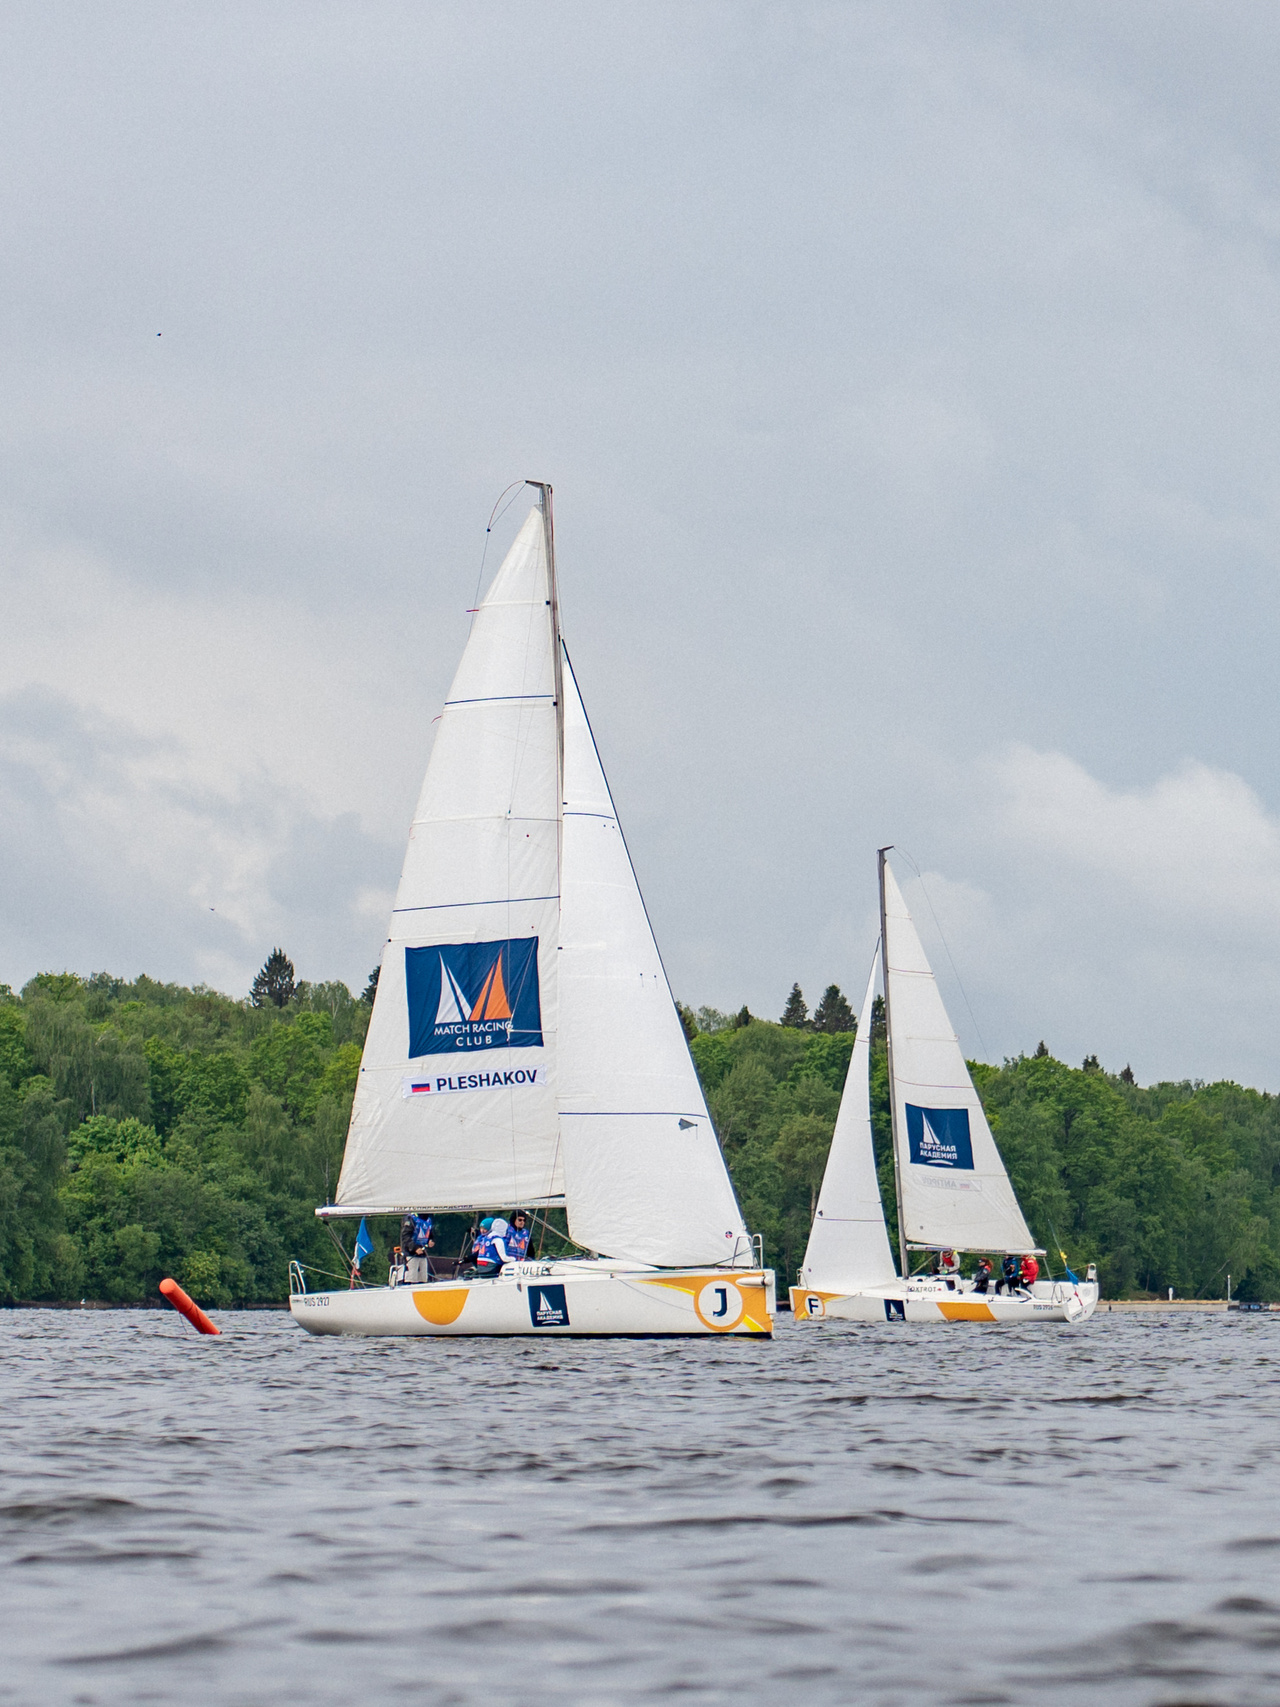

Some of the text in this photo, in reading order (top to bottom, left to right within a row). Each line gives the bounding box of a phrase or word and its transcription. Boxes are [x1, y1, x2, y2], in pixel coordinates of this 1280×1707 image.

[434, 1021, 513, 1036] MATCH RACING
[455, 1035, 492, 1047] CLUB
[436, 1069, 537, 1091] PLESHAKOV
[919, 1141, 957, 1152] ПАРУСНАЯ
[919, 1149, 958, 1160] АКАДЕМИЯ
[712, 1288, 728, 1317] J
[808, 1298, 818, 1314] F
